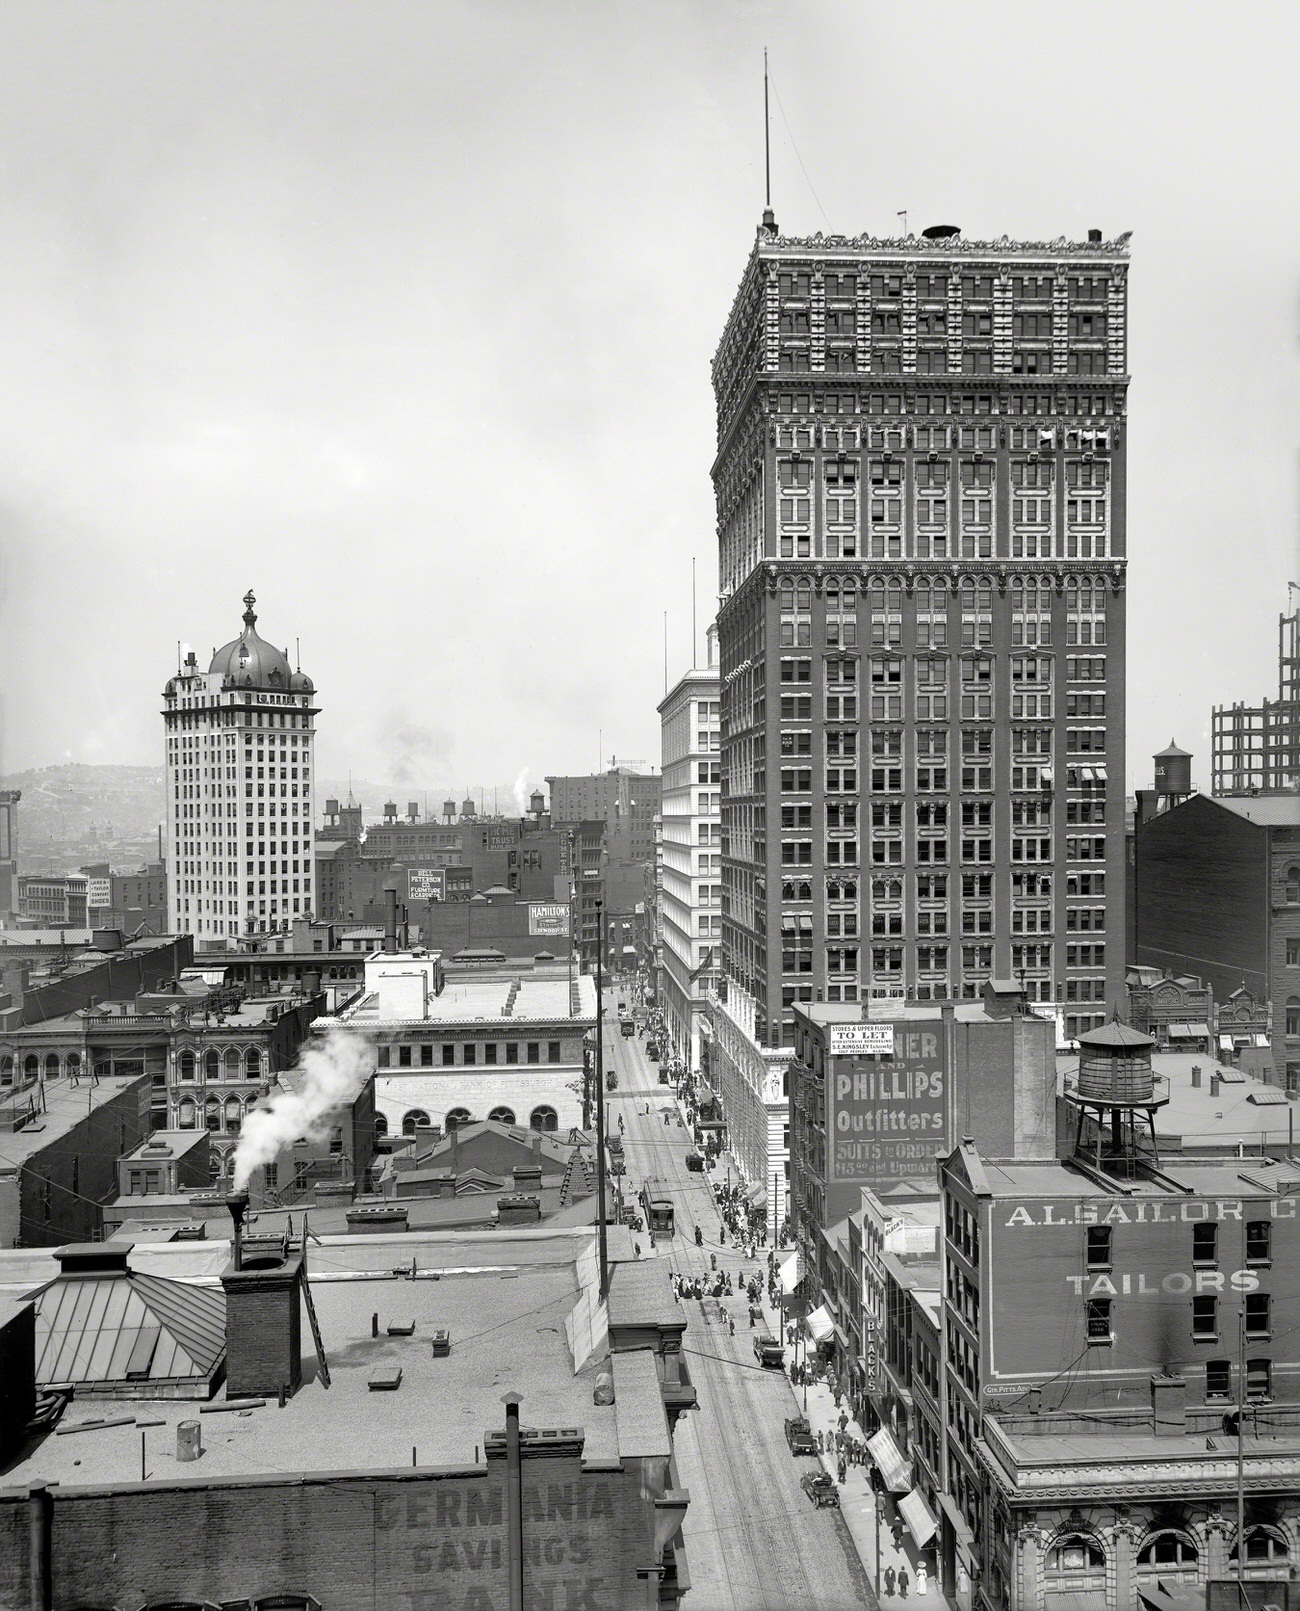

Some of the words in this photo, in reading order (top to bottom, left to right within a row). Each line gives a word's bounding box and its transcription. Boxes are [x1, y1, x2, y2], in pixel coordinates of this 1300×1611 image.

[491, 836, 515, 844] TRUST
[531, 905, 570, 919] HAMILTON'S
[837, 1031, 855, 1039] TO
[862, 1031, 887, 1039] LET
[876, 1062, 906, 1070] AND
[837, 1071, 943, 1100] PHILLIPS
[837, 1109, 943, 1132] Outfitters
[837, 1143, 881, 1160] SUITS
[1066, 1270, 1260, 1295] TAILORS
[376, 1482, 616, 1530] GERMANIA
[412, 1535, 592, 1574] SAVINGS
